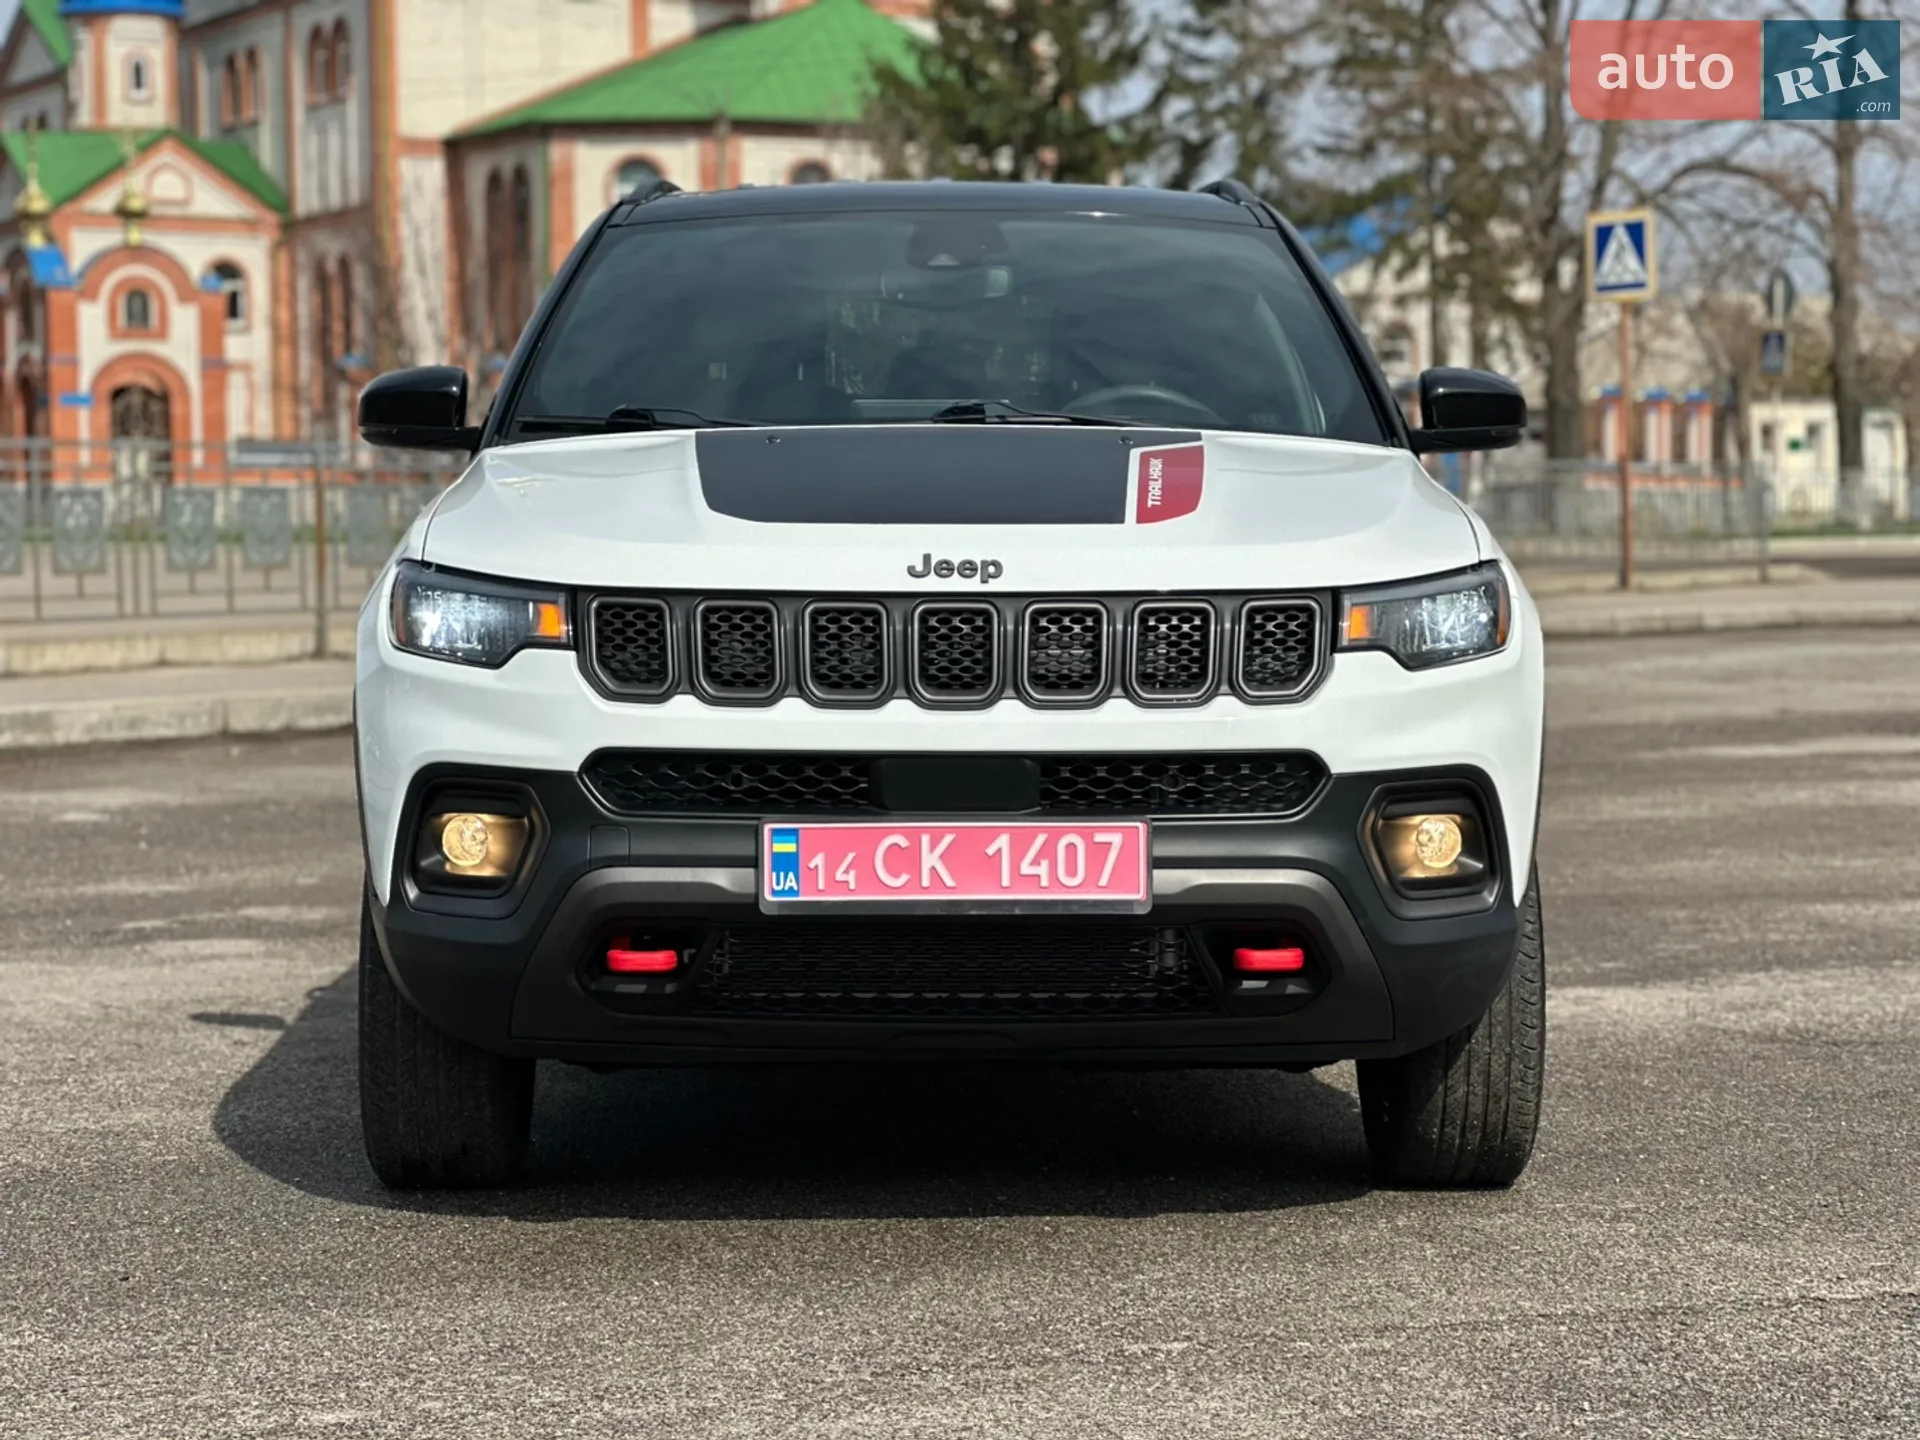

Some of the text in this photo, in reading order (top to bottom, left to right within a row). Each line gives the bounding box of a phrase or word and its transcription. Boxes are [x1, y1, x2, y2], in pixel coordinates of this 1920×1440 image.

[907, 553, 1004, 584] Jeep
[807, 832, 1124, 891] 14 CK 1407
[772, 871, 798, 891] UA
